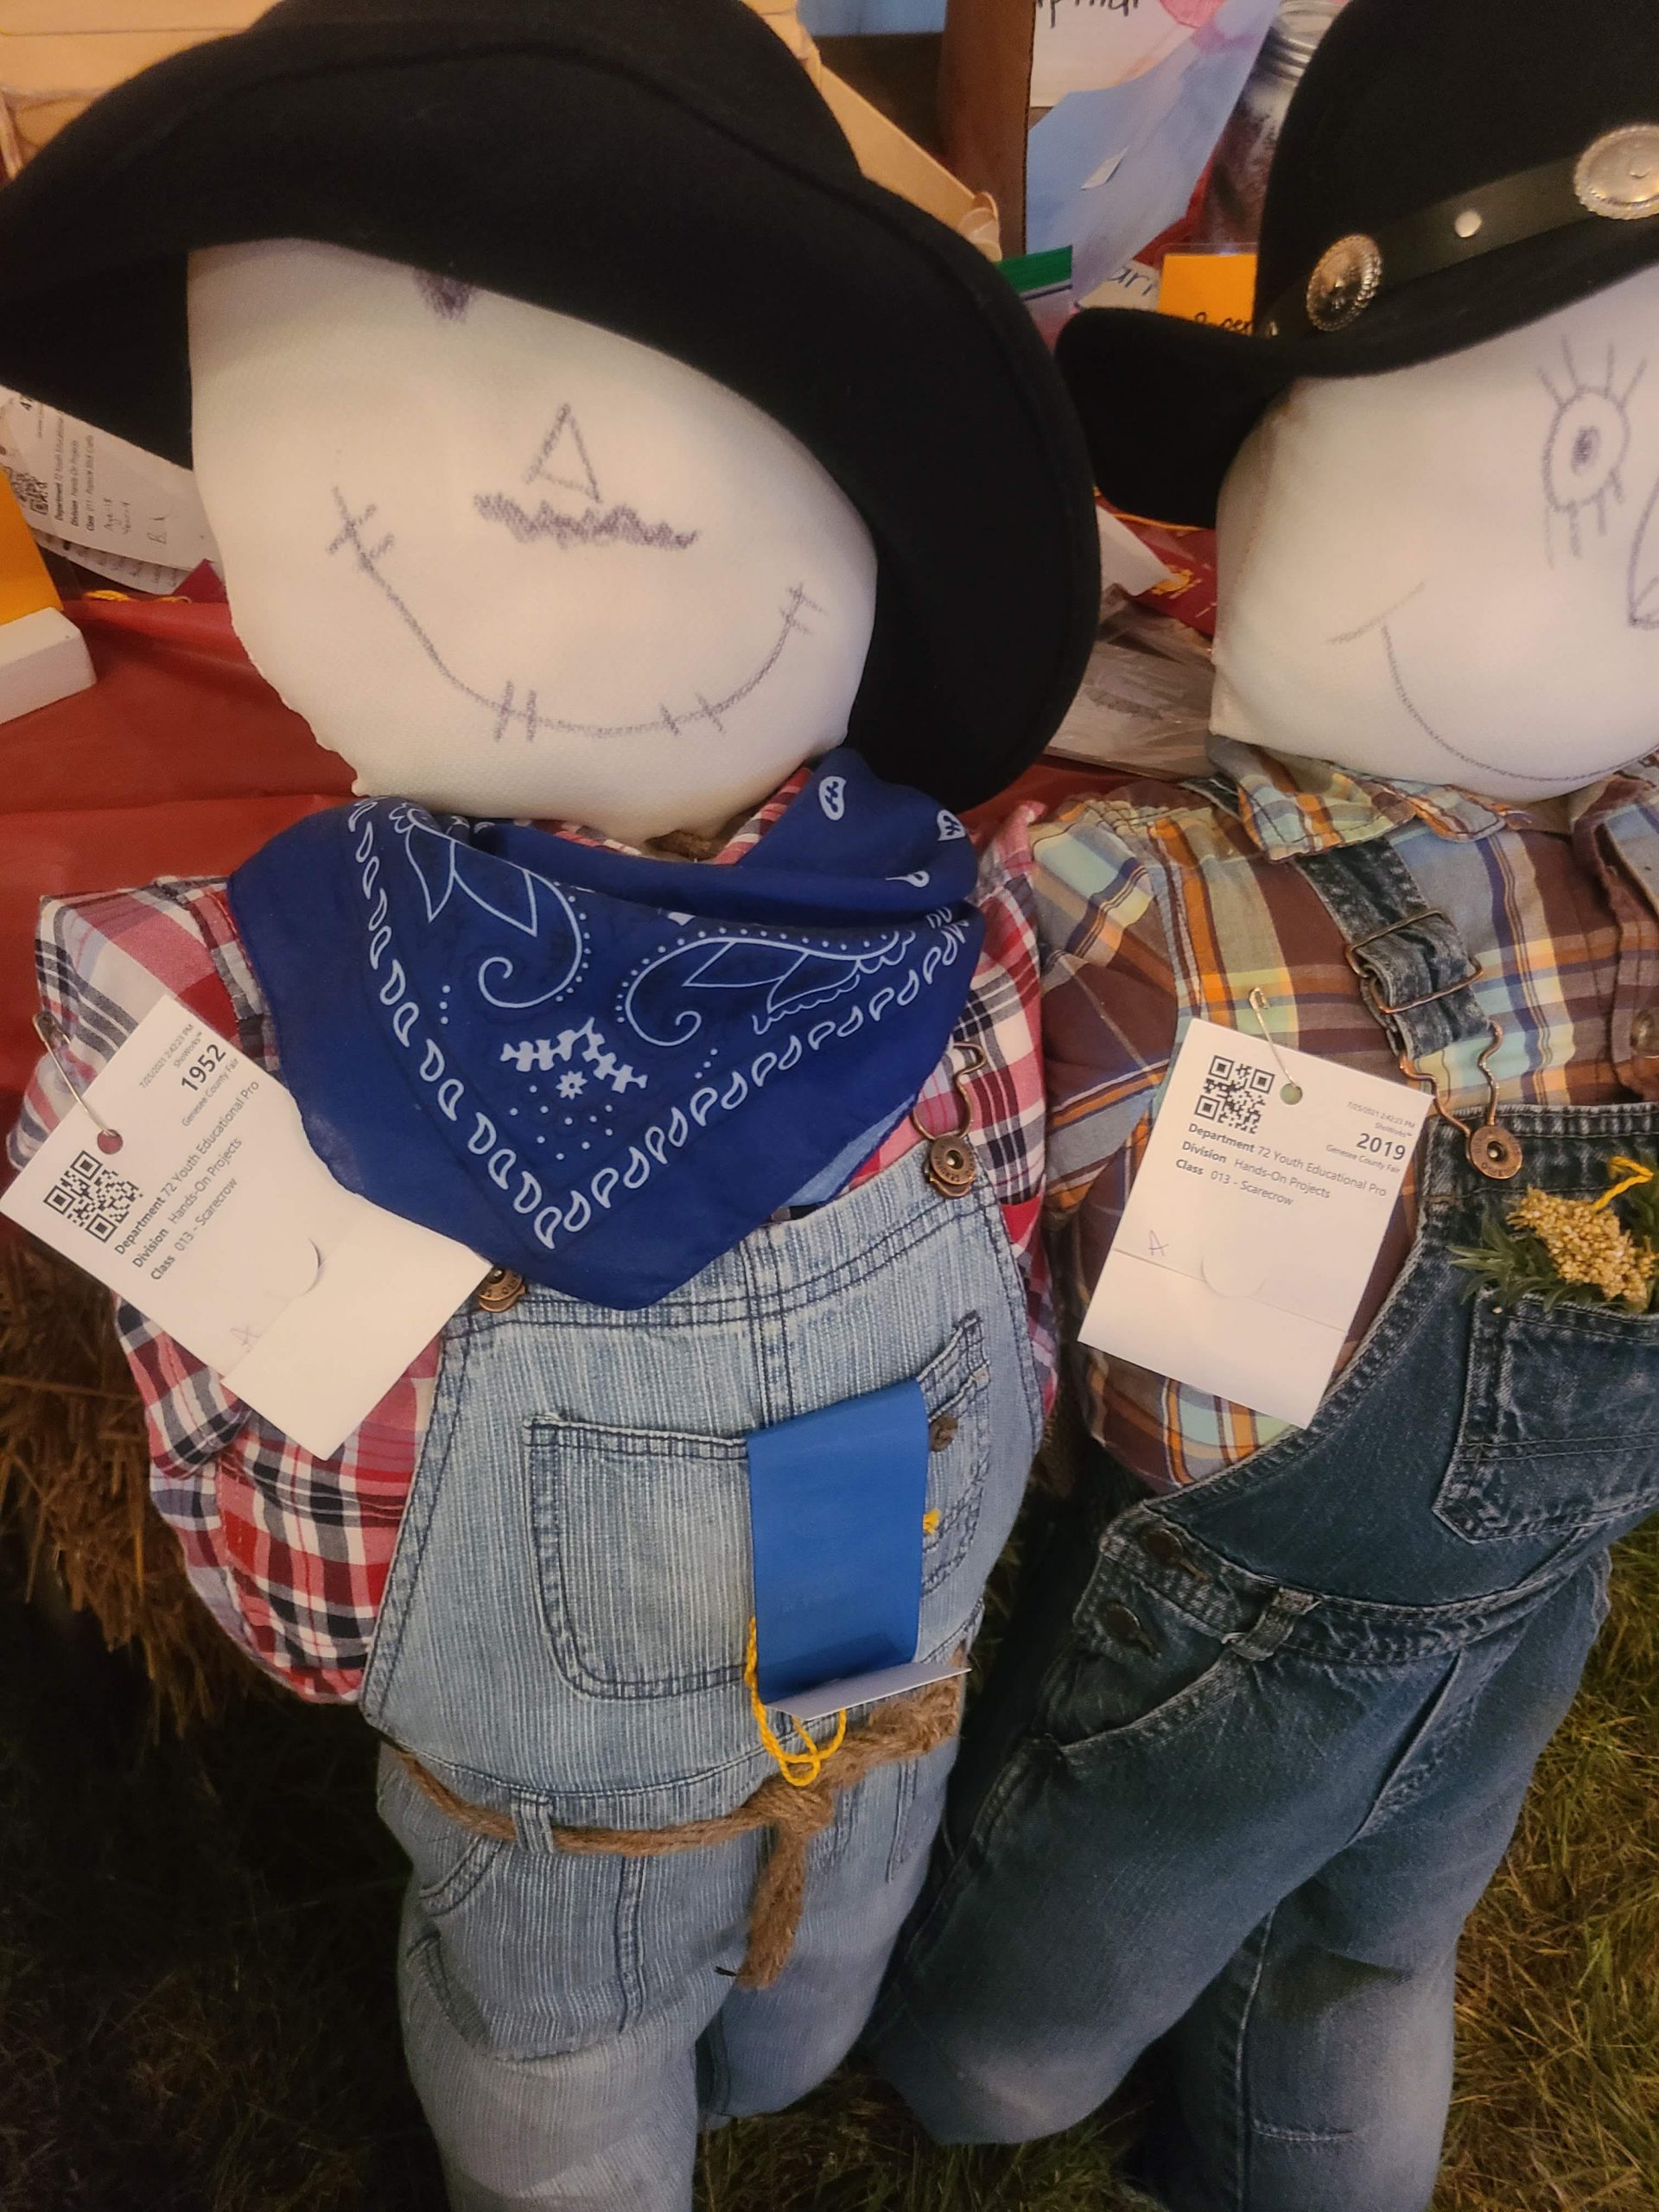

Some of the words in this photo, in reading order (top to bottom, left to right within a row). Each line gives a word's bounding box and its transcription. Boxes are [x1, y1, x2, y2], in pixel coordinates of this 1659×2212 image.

[54, 482, 65, 522] Department
[71, 500, 79, 526] Division
[181, 1023, 194, 1036] PM
[181, 1043, 226, 1091] 1952
[181, 1096, 208, 1127] Genesee
[205, 1071, 229, 1099] County
[226, 1058, 239, 1073] Fair
[114, 1196, 167, 1255] Department
[161, 1181, 178, 1198] 72
[172, 1153, 200, 1184] Youth
[195, 1097, 245, 1155] Educational
[240, 1081, 259, 1101] Pro
[1181, 1140, 1227, 1164] Division
[1234, 1158, 1287, 1185] Hands-On
[1288, 1176, 1332, 1199] Projects
[1188, 1122, 1255, 1154] Department
[1257, 1145, 1272, 1159] 72
[1274, 1152, 1305, 1170] Youth
[1306, 1162, 1367, 1191] Educational
[1368, 1182, 1388, 1198] Pro
[1325, 1144, 1358, 1160] Genesee
[1358, 1155, 1384, 1171] County
[1386, 1164, 1402, 1173] Fair
[1356, 1132, 1406, 1160] 2019
[132, 1228, 169, 1268] Division
[168, 1173, 213, 1225] Hands-On
[207, 1137, 243, 1177] Projects
[1175, 1158, 1205, 1176] Class
[1211, 1170, 1231, 1185] 013
[1240, 1180, 1294, 1206] Scarecrow
[150, 1255, 175, 1281] Class
[173, 1230, 194, 1252] 013
[194, 1177, 238, 1226] Scarecrow
